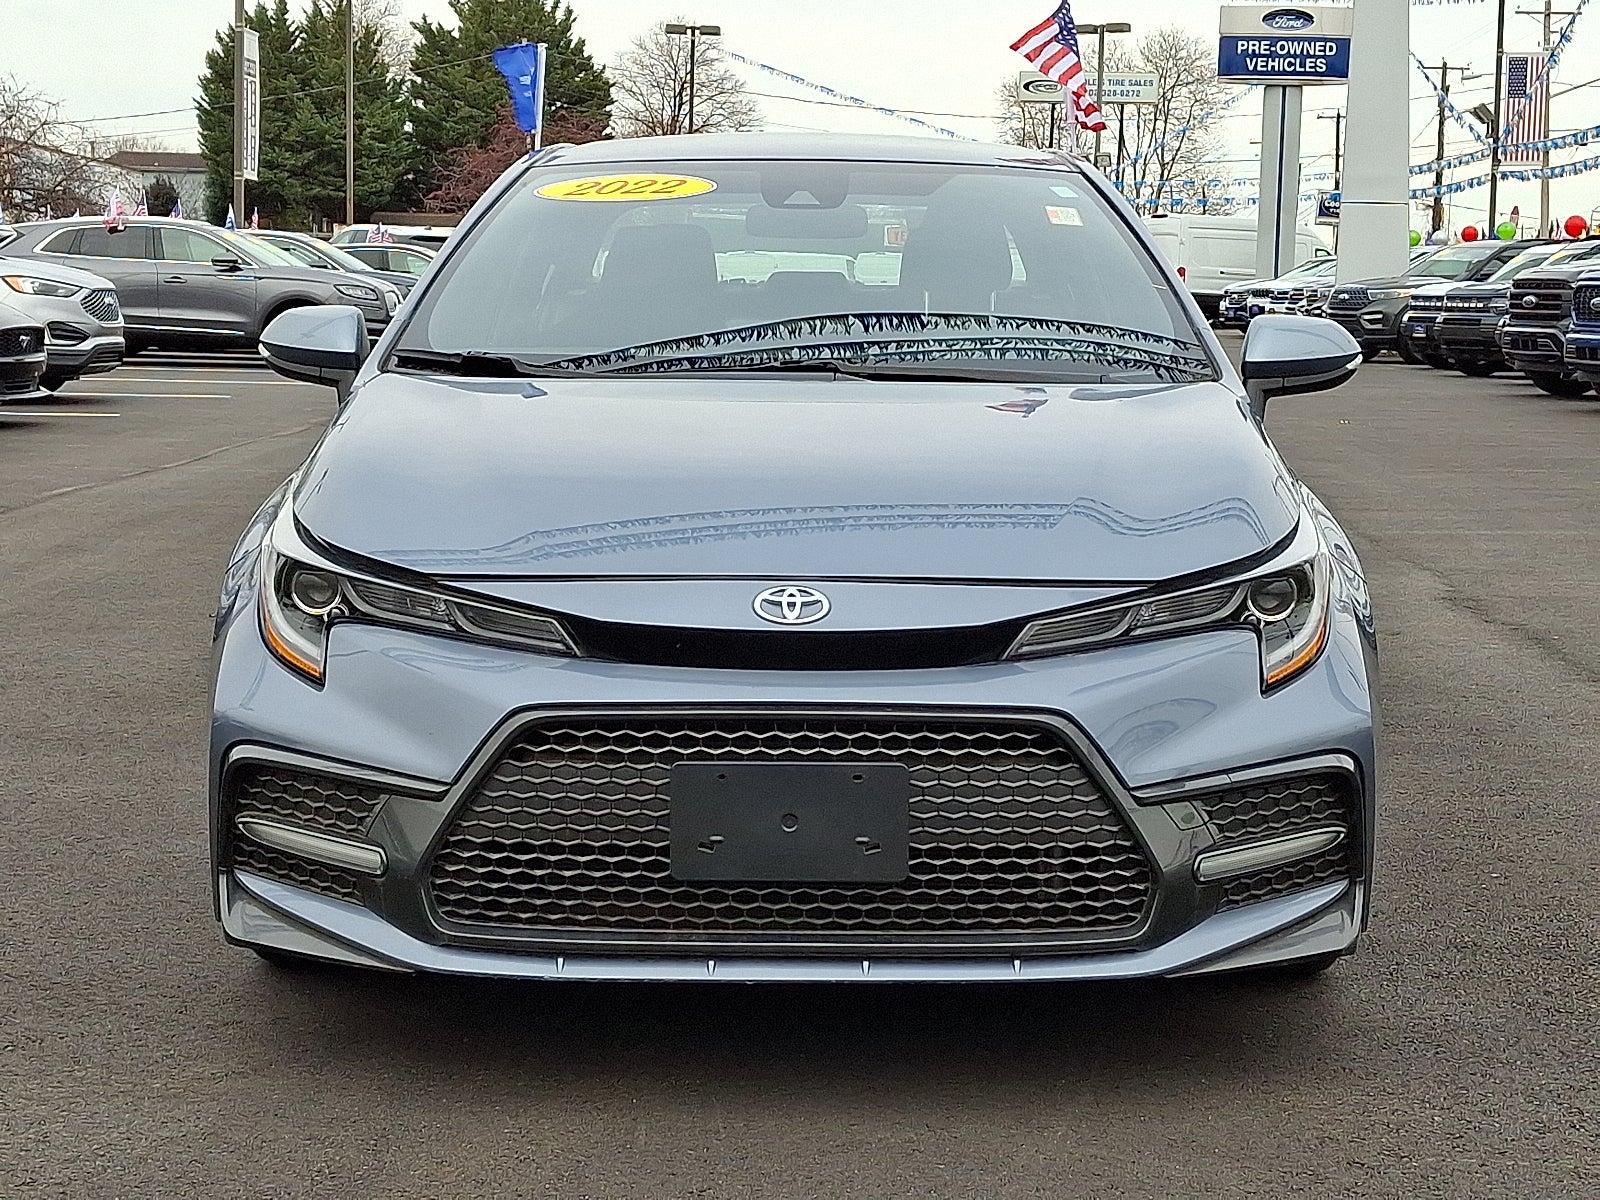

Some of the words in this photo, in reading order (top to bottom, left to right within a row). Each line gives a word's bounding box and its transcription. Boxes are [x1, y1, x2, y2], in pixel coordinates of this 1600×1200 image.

[1272, 15, 1304, 28] Ford
[1237, 40, 1337, 56] PRE-OWNED
[1246, 57, 1327, 72] VEHICLES
[1107, 79, 1126, 87] TIRE
[1128, 79, 1154, 87] SALES
[563, 179, 687, 196] 2022
